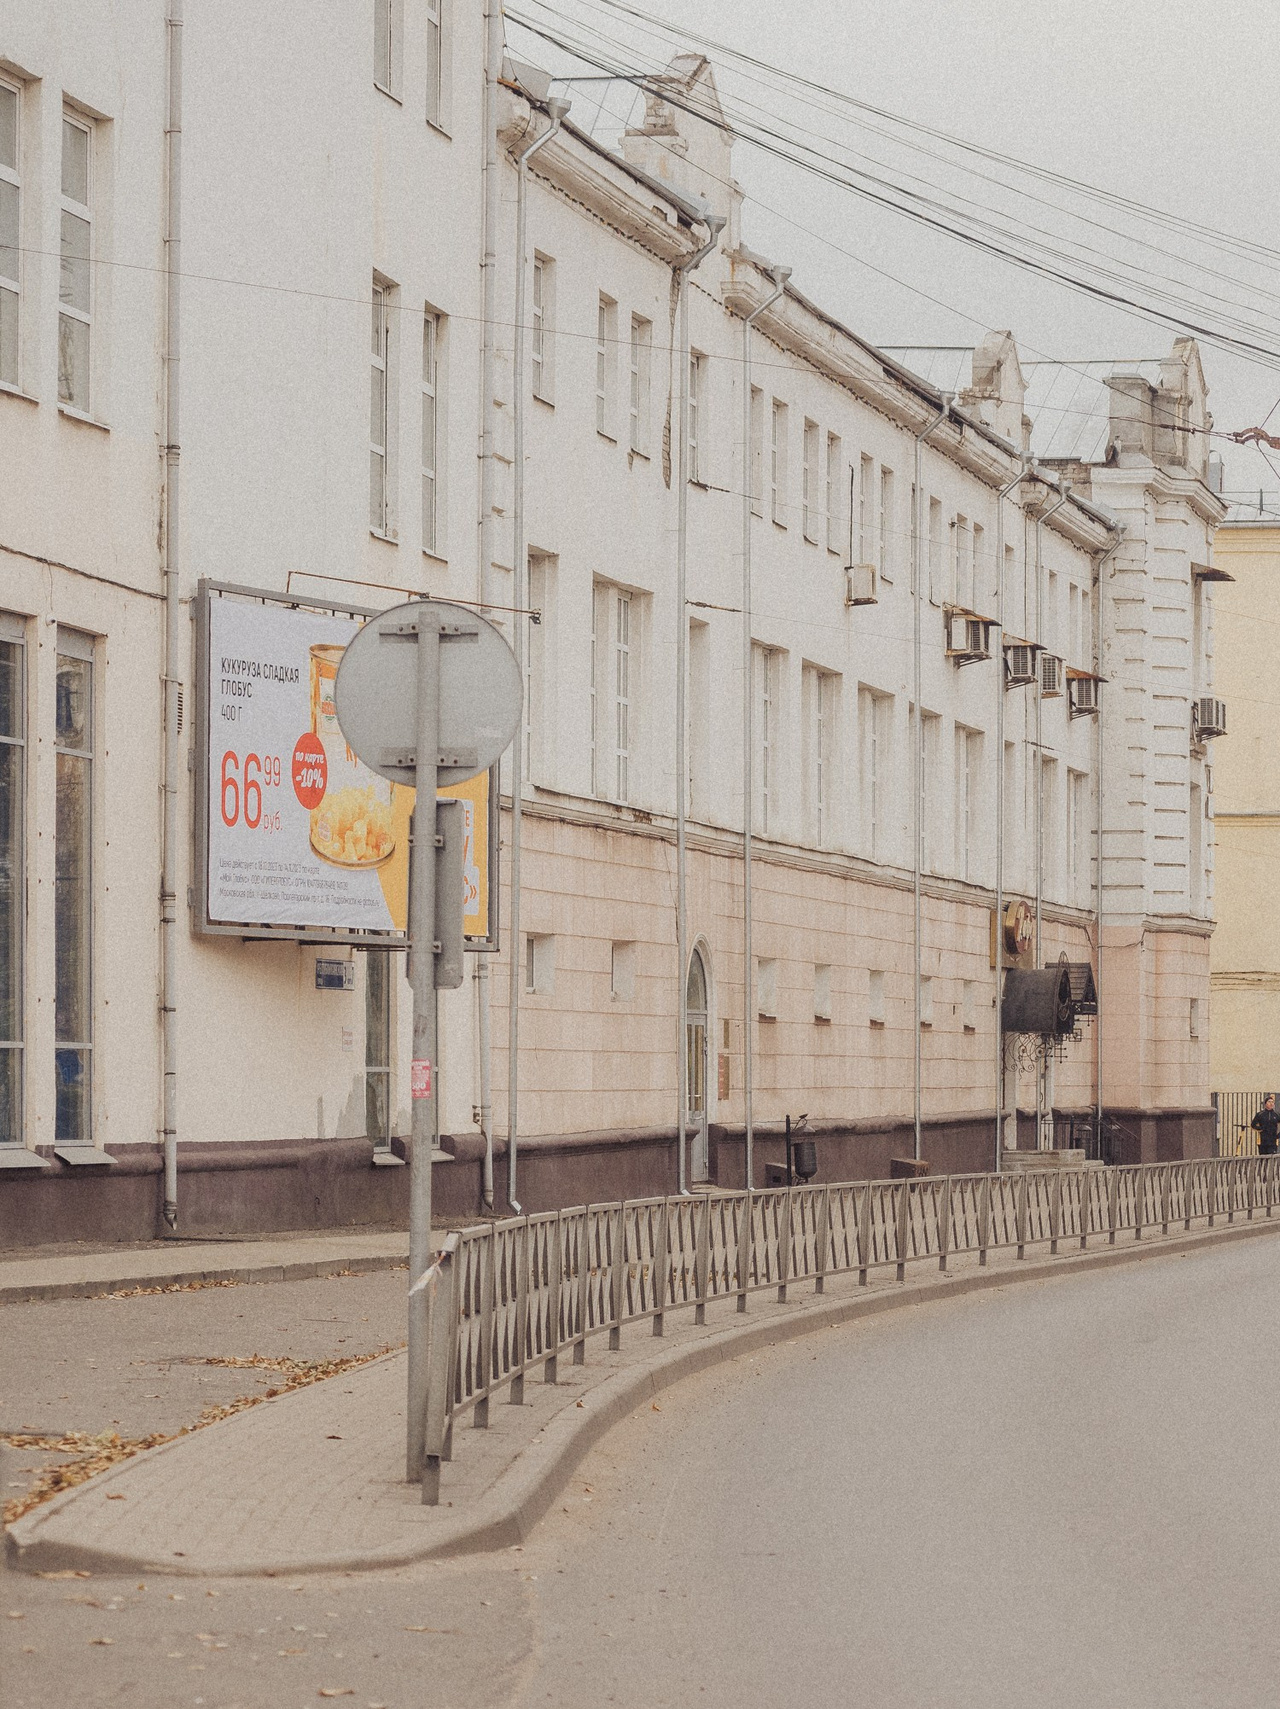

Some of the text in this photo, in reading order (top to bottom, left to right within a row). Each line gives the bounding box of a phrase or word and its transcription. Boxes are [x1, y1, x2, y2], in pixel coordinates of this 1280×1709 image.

[221, 657, 299, 684] КУКУРУЗА СЛАДКАЯ
[221, 679, 252, 698] ГЛОБУС
[221, 704, 236, 721] 400
[221, 750, 262, 829] 66
[264, 755, 280, 787] 99
[295, 768, 323, 789] -10%
[263, 811, 283, 834] руб.
